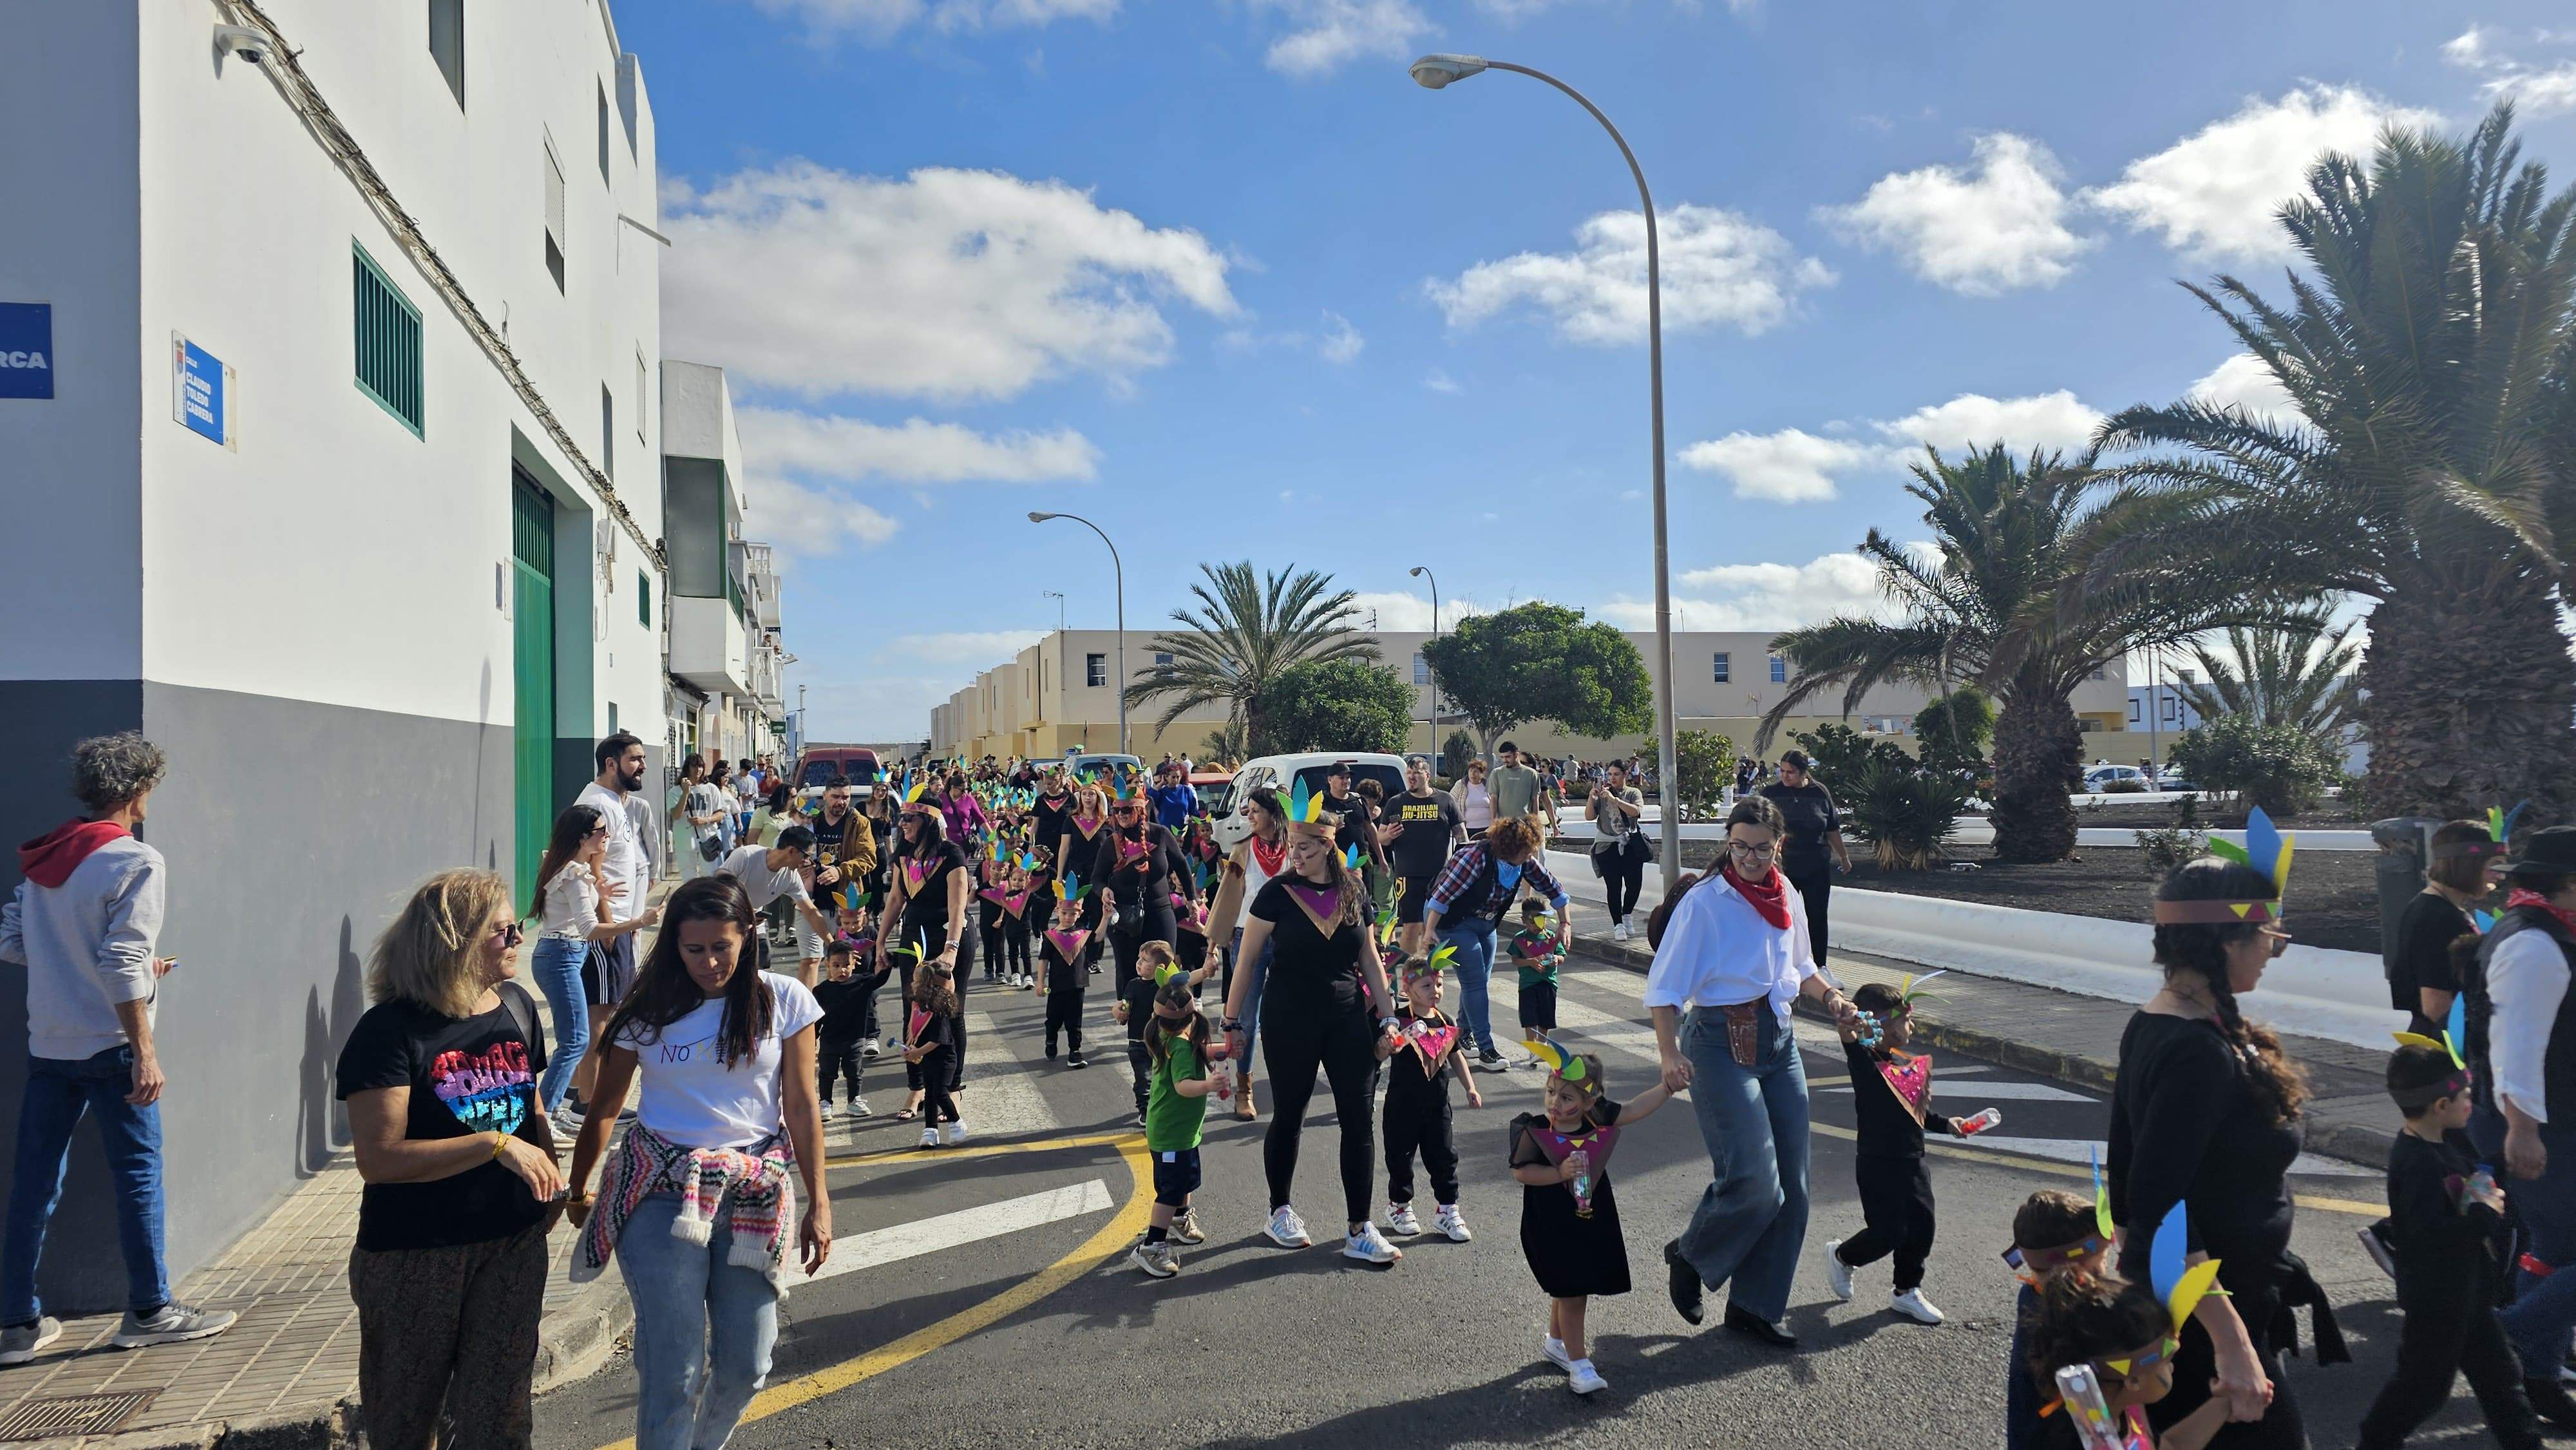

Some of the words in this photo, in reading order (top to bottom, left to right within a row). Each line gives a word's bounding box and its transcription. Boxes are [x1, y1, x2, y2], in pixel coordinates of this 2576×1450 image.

[186, 372, 211, 395] CLAUDIO
[186, 385, 209, 408] TOLEDO
[186, 400, 214, 424] CABRERA
[1401, 811, 1438, 819] JIU-JITSU
[661, 1044, 689, 1064] NO
